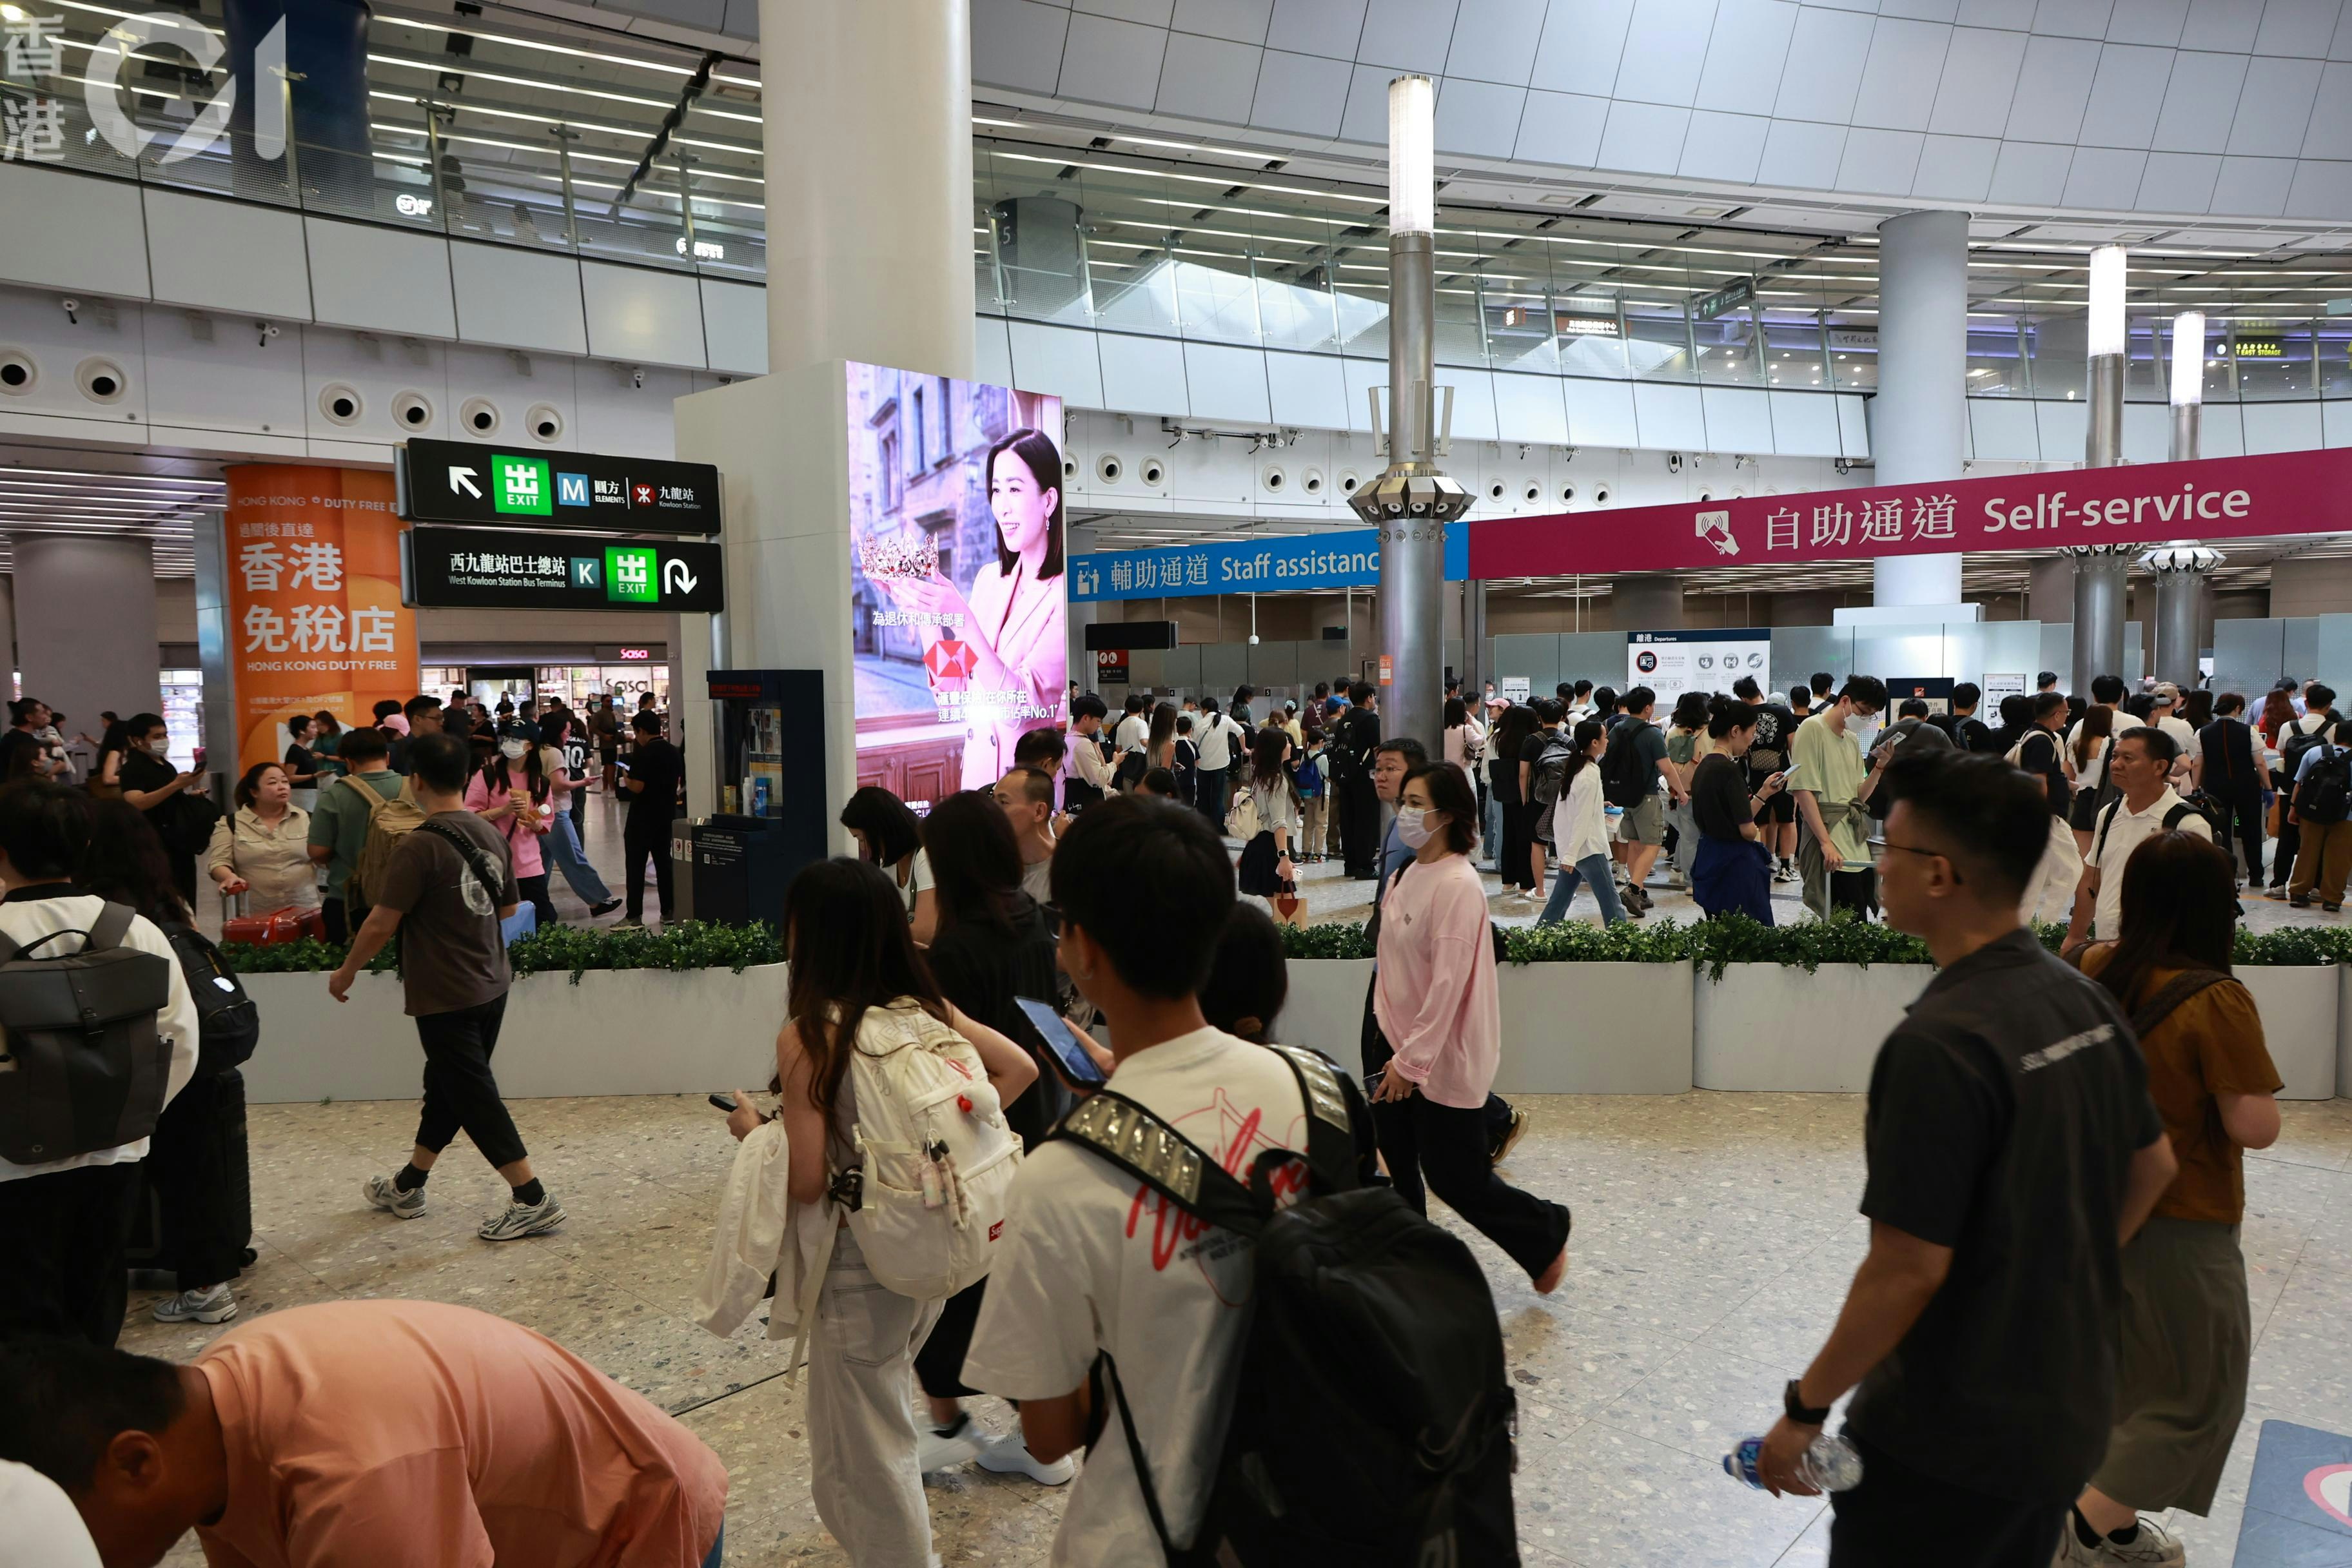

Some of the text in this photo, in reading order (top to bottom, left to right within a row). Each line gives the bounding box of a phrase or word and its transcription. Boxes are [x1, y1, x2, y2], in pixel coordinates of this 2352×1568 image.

[505, 464, 539, 495] 出
[562, 478, 585, 502] M
[594, 480, 694, 501] 圓方 九龍站
[237, 496, 267, 506] HONG
[269, 496, 306, 507] KONG
[324, 498, 356, 509] DUTY
[358, 501, 386, 511] FREE
[506, 494, 539, 506] EXIT
[595, 495, 625, 504] ELEMENTS
[659, 500, 682, 509] Kowloon
[1983, 482, 2251, 533] Self-service
[1766, 493, 1958, 551] 自助通道
[240, 542, 344, 592] 香港
[449, 553, 565, 576] 西九龍站巴士總站
[578, 562, 594, 585] K
[616, 554, 647, 583] 出
[1110, 553, 1209, 592] 輔助通道
[1221, 549, 1380, 581] Staff assistanc
[448, 575, 565, 588] West Kowloon Station Bus Terminus
[618, 582, 647, 594] EXIT
[243, 603, 395, 654] 免稅店
[872, 611, 965, 628] 為退休和傳承部署
[1636, 634, 1652, 643] 離港
[247, 660, 397, 672] HONG KONG DUTY FREE
[938, 689, 1027, 705] 滙豐保險 在你所在
[562, 745, 584, 769] 10
